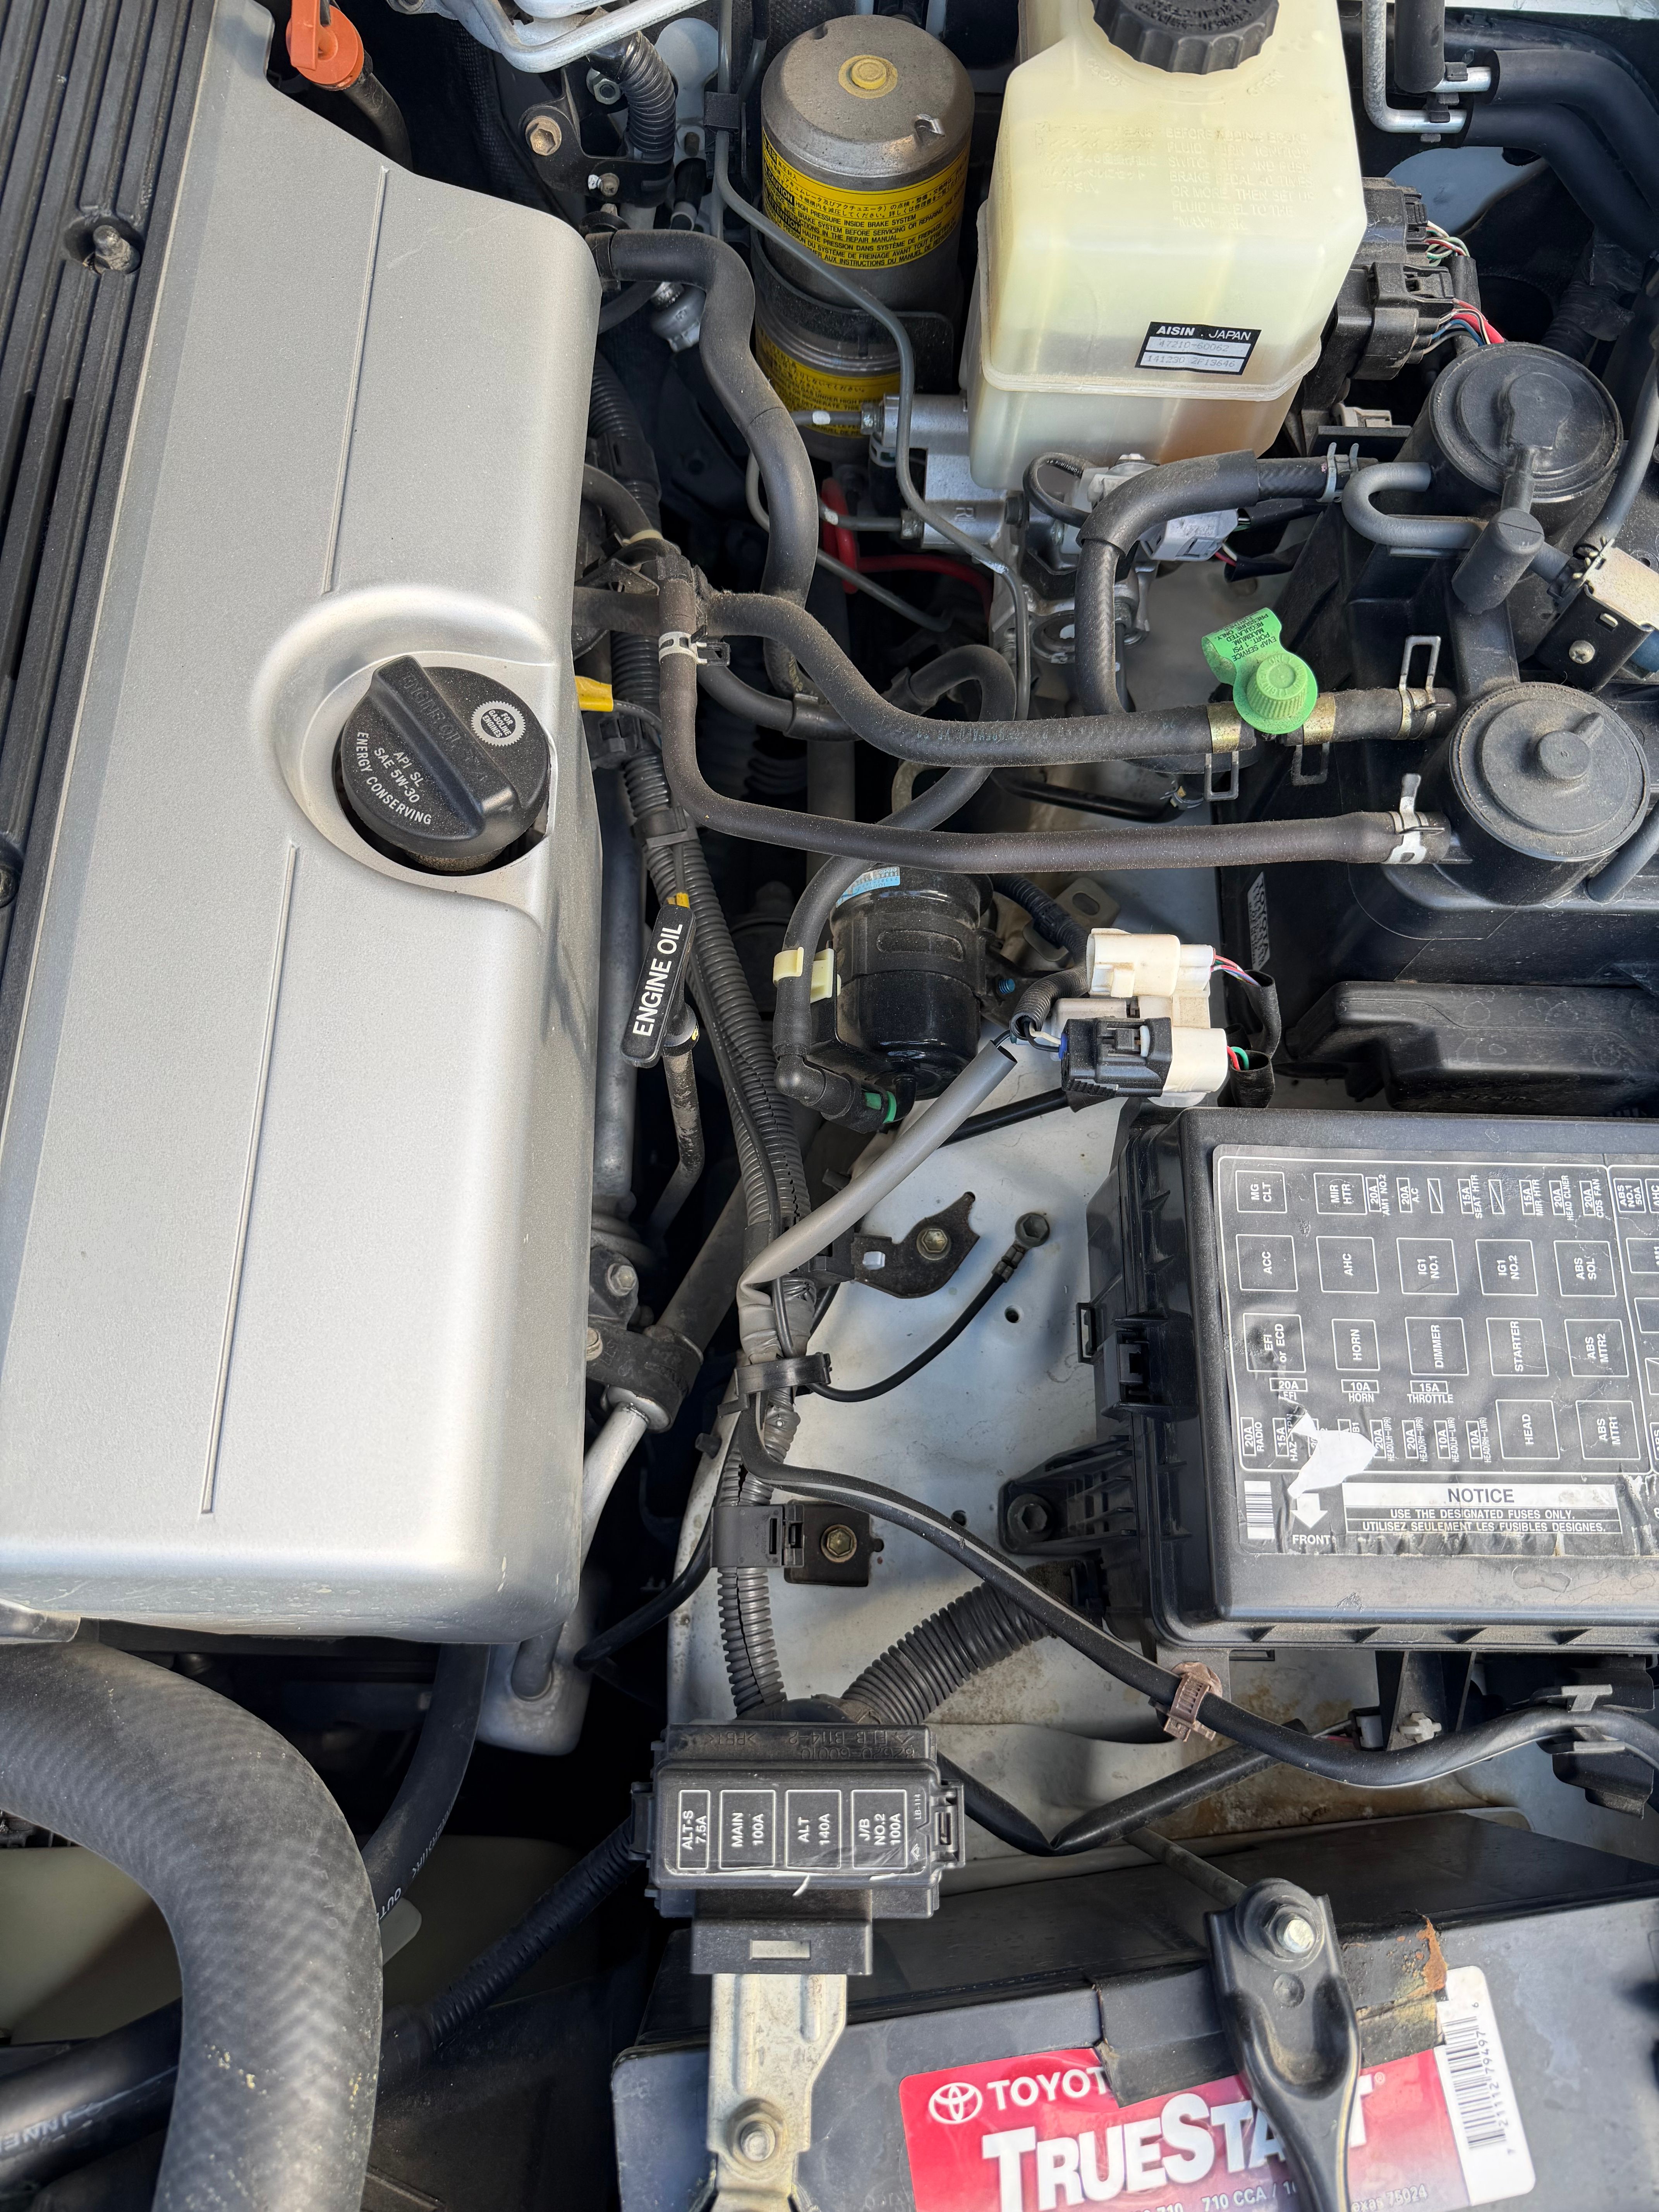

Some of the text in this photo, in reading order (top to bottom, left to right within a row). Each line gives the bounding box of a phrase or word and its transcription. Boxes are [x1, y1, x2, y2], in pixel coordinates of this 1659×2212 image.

[1170, 171, 1211, 184] BRAKE
[1171, 185, 1188, 197] OR
[795, 201, 808, 213] HIGH
[811, 207, 841, 224] PRESSURE
[844, 220, 865, 228] INSIDE
[892, 214, 916, 225] SYSTEM
[1172, 201, 1207, 214] FLUID
[798, 210, 917, 236] BRAKE SYSTEM BEFORE SERVICING OR
[802, 228, 821, 242] HAUTE
[823, 237, 853, 250] PRESSION
[918, 222, 942, 241] FREINAGE
[831, 231, 843, 240] THE
[846, 234, 869, 242] REPAIR
[807, 240, 816, 248] DU
[859, 251, 890, 260] FREINAGE
[892, 247, 911, 257] AVANT
[914, 238, 927, 249] TOUT
[899, 250, 922, 263] MANUEL
[1156, 326, 1251, 341] AISIN JAPAN
[1159, 339, 1230, 352] 47210-60062
[1147, 355, 1185, 363] 141230
[1226, 621, 1264, 642] REGULATED
[1231, 635, 1276, 662] EVAP SERVICE
[1232, 644, 1243, 653] PSI
[482, 714, 503, 738] ENGINES
[488, 709, 512, 736] GASOLINE
[501, 712, 514, 726] FOR
[356, 732, 432, 825] ENERGY CONSERVING
[373, 747, 420, 803] SAE 5W-30
[393, 751, 423, 788] API SL
[632, 924, 683, 1037] ENGINE OIL
[1250, 1183, 1260, 1200] MG
[1262, 1182, 1272, 1202] CLT
[1330, 1184, 1340, 1204] MIR
[1341, 1183, 1353, 1204] HTR
[1370, 1185, 1379, 1204] 20A
[1378, 1174, 1390, 1216] AM1 NO.2
[1400, 1185, 1410, 1205] 20A
[1462, 1187, 1471, 1206] 15A
[1470, 1174, 1483, 1219] SEAT HTR
[1523, 1188, 1532, 1206] 15A
[1532, 1179, 1544, 1216] MIR HTR
[1553, 1188, 1563, 1208] 20A
[1561, 1175, 1575, 1221] HEAD CLNER
[1582, 1188, 1594, 1207] 20A
[1592, 1178, 1604, 1218] CDS FAN
[1616, 1185, 1627, 1206] ABS
[1626, 1185, 1636, 1208] NO.1
[1634, 1186, 1644, 1206] 50A
[1262, 1251, 1273, 1275] ACC
[1342, 1253, 1353, 1276] AHC
[1417, 1258, 1427, 1276] IG1
[1428, 1255, 1440, 1279] NO.1
[1496, 1259, 1507, 1276] IG1
[1508, 1255, 1520, 1280] NO.2
[1574, 1257, 1585, 1280] ABS
[1586, 1258, 1597, 1280] SOL
[1263, 1334, 1274, 1351] EFI
[1274, 1323, 1287, 1363] or ECD
[1350, 1329, 1363, 1361] HORN
[1431, 1324, 1444, 1369] DIMMER
[1510, 1321, 1523, 1372] STARTER
[1585, 1336, 1596, 1359] ABS
[1597, 1333, 1609, 1363] MTR2
[1278, 1380, 1299, 1390] 20A
[1283, 1391, 1297, 1400] EFI
[1350, 1382, 1370, 1392] 10A
[1419, 1383, 1439, 1393] 15A
[1348, 1393, 1375, 1402] HORN
[1407, 1394, 1454, 1403] THROTTLE
[1244, 1425, 1254, 1447] 20A
[1255, 1421, 1265, 1452] RADIO
[1276, 1427, 1286, 1446] 15A
[1382, 1417, 1395, 1462] HEAD(LH-UPR)
[1406, 1429, 1417, 1450] 20A
[1415, 1417, 1428, 1462] HEAD(RH-UPR)
[1438, 1429, 1448, 1449] 10A
[1446, 1417, 1460, 1463] HEAD(LH-LWR)
[1470, 1429, 1480, 1449] 10A
[1478, 1417, 1491, 1463] HEAD(RH-LWR)
[1521, 1413, 1535, 1445] HEAD
[1596, 1418, 1609, 1441] ABS
[1608, 1416, 1621, 1445] MTR1
[1447, 1488, 1515, 1503] NOTICE
[1390, 1509, 1575, 1520] USE THE DESIGNATED FUSES ONLY.
[1362, 1521, 1606, 1532] UTILISEZ SEULEMENT LES FUSIBLES DESIGNES.
[1292, 1534, 1331, 1545] FRONT
[682, 1810, 694, 1850] ALT-S
[695, 1815, 707, 1844] 7.5A
[731, 1812, 744, 1848] MAIN
[752, 1813, 764, 1845] 100A
[797, 1817, 810, 1843] ALT
[818, 1813, 831, 1846] 140A
[858, 1818, 870, 1841] J/B
[873, 1813, 886, 1846] NO.2
[889, 1812, 902, 1845] 100A
[1476, 2030, 1495, 2075] 79497
[987, 2066, 1109, 2111] TOYOT
[982, 2074, 1373, 2212] TRUESTAT
[1233, 2186, 1267, 2207] CCA
[1351, 2184, 1428, 2212] exas 75024
